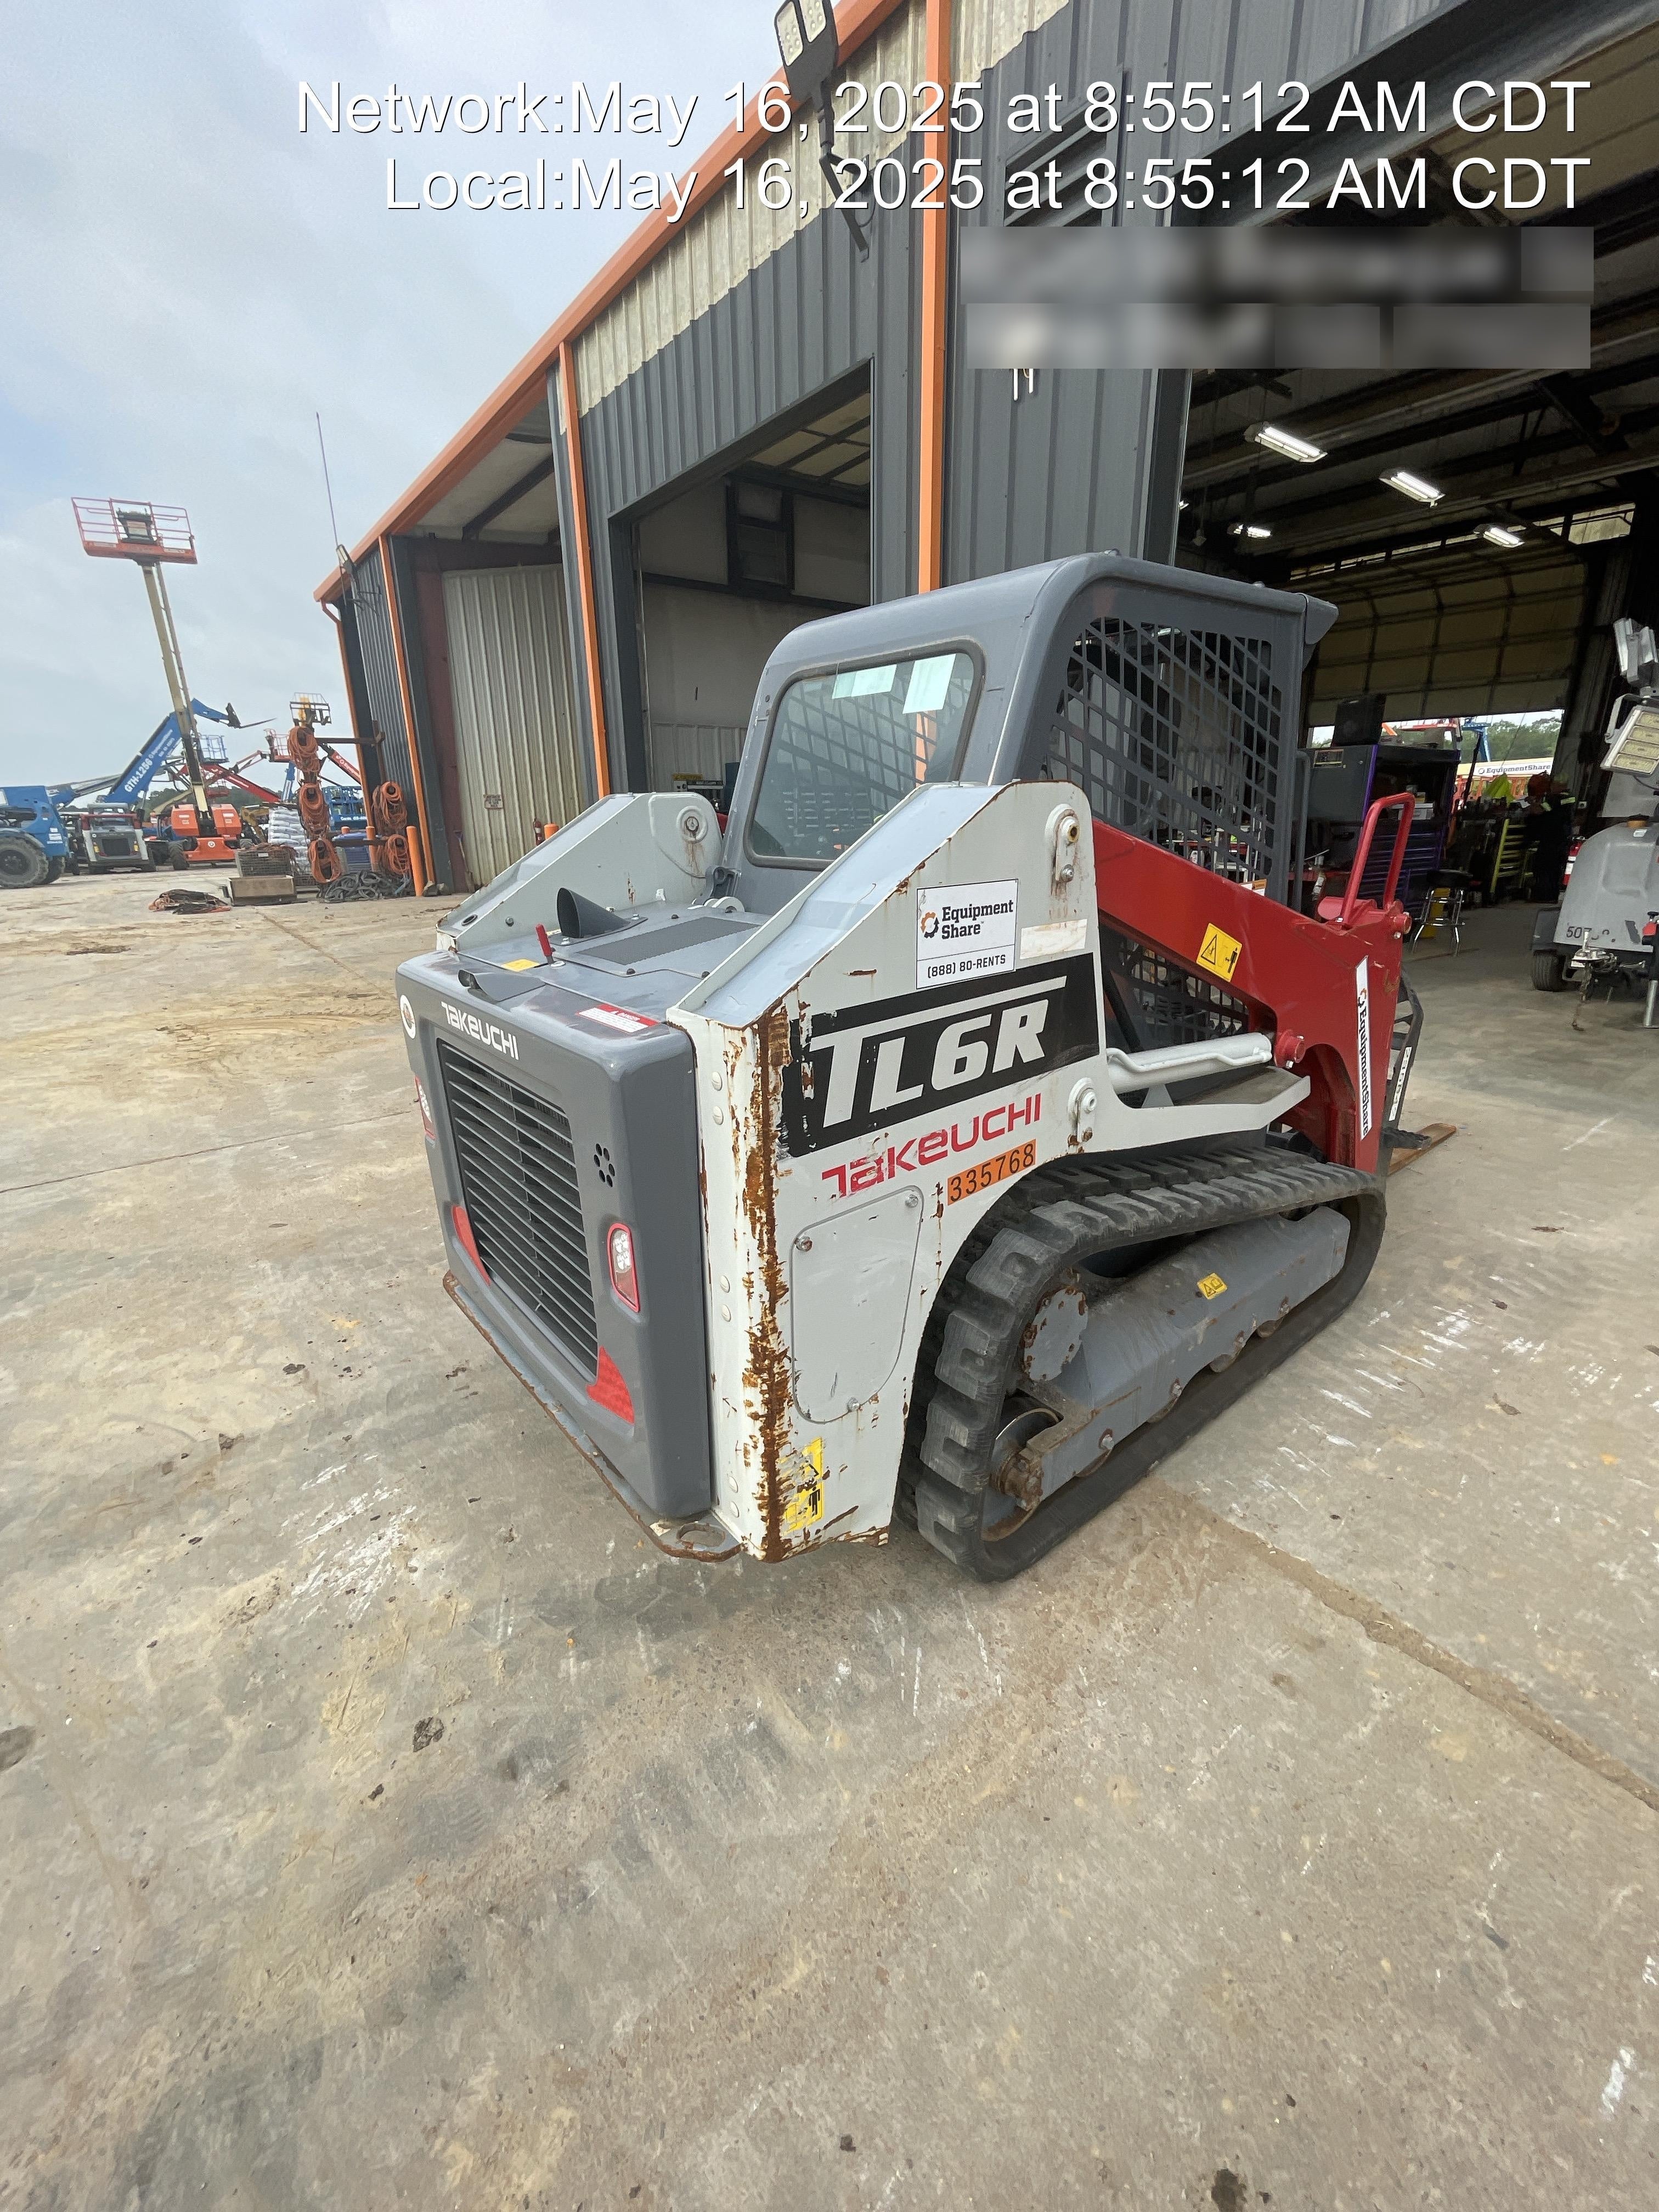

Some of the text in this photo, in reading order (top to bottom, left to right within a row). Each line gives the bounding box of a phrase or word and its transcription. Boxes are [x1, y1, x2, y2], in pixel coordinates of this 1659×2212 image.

[124, 758, 153, 792] GTH-1256
[1486, 764, 1551, 774] EquipmentShare
[941, 899, 1014, 923] Equipment
[941, 923, 981, 940] Share
[928, 954, 1006, 978] (888) 80-RENTS
[809, 975, 1068, 1128] TL6R
[1358, 1006, 1369, 1136] EquipmentShare
[950, 1143, 1035, 1203] 335768
